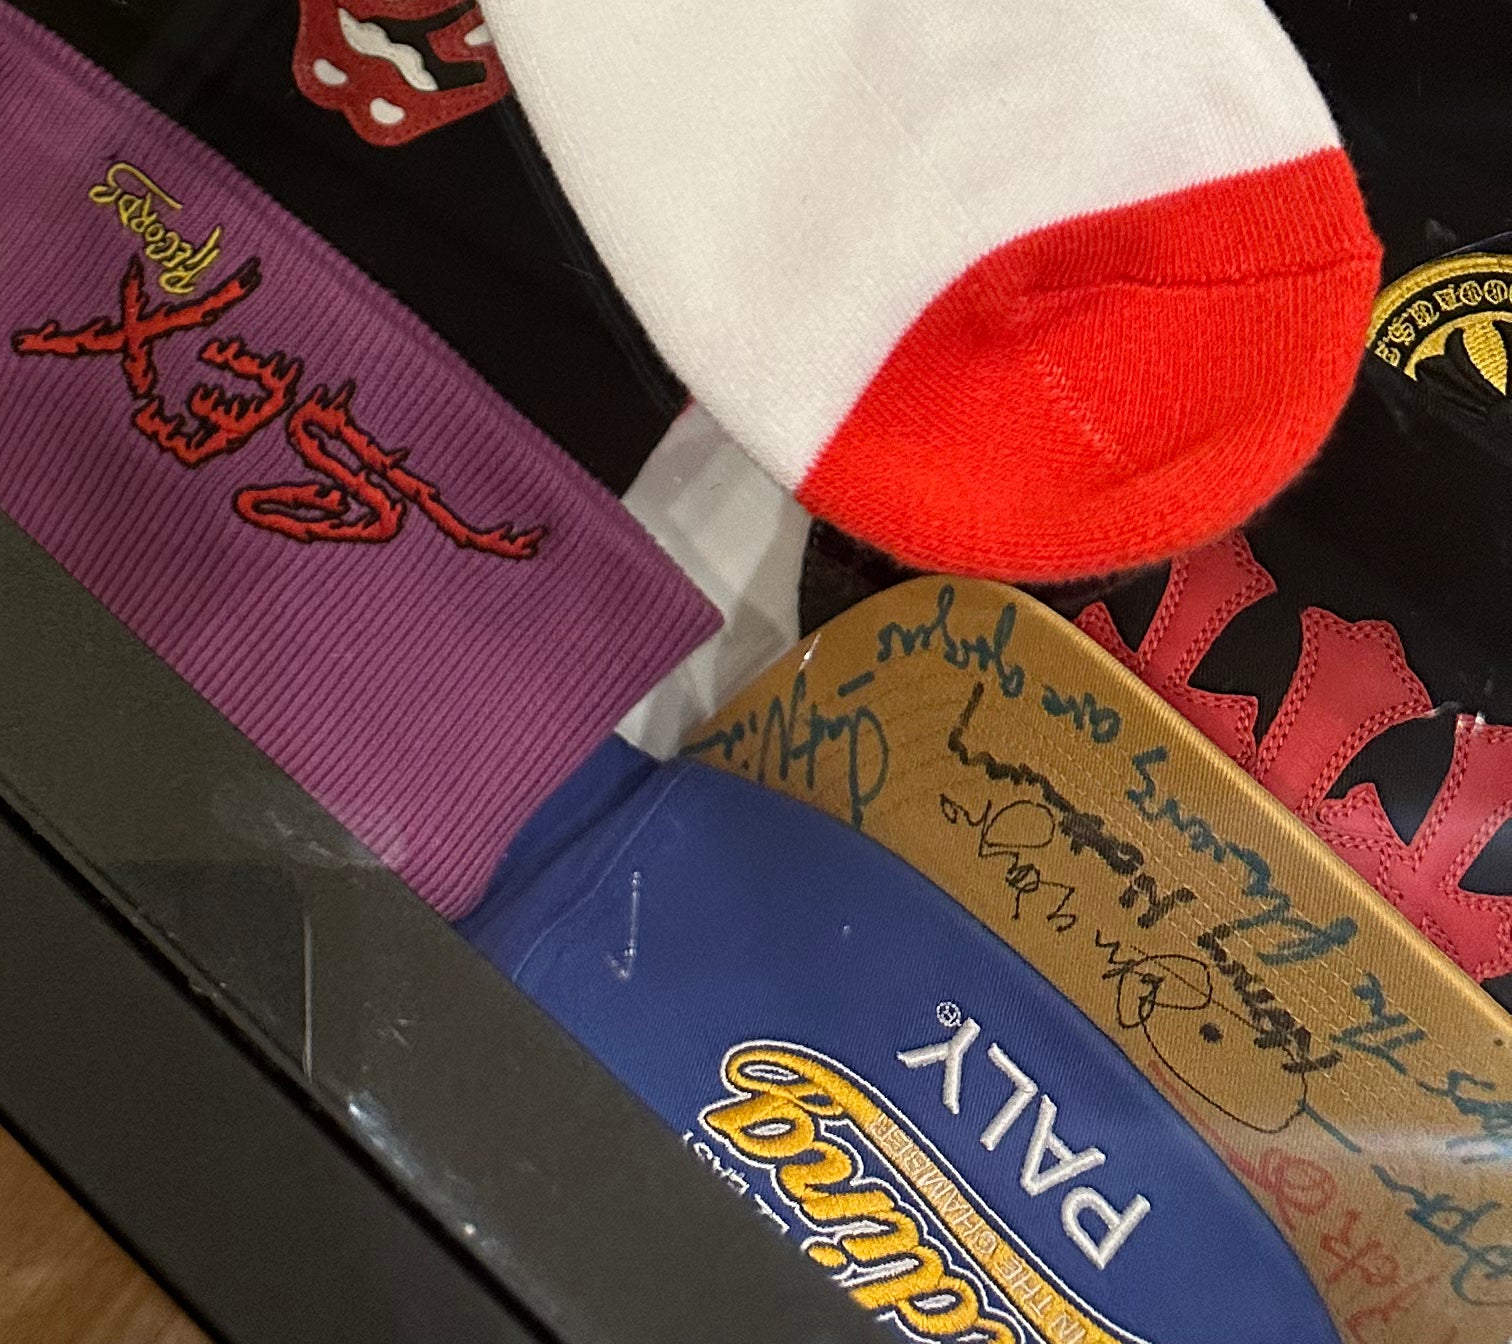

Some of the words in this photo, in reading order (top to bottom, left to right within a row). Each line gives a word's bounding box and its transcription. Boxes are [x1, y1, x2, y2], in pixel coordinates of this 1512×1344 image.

[1432, 278, 1512, 312] OOD
[11, 254, 548, 560] SEX
[870, 1112, 1002, 1258] CHAMBER
